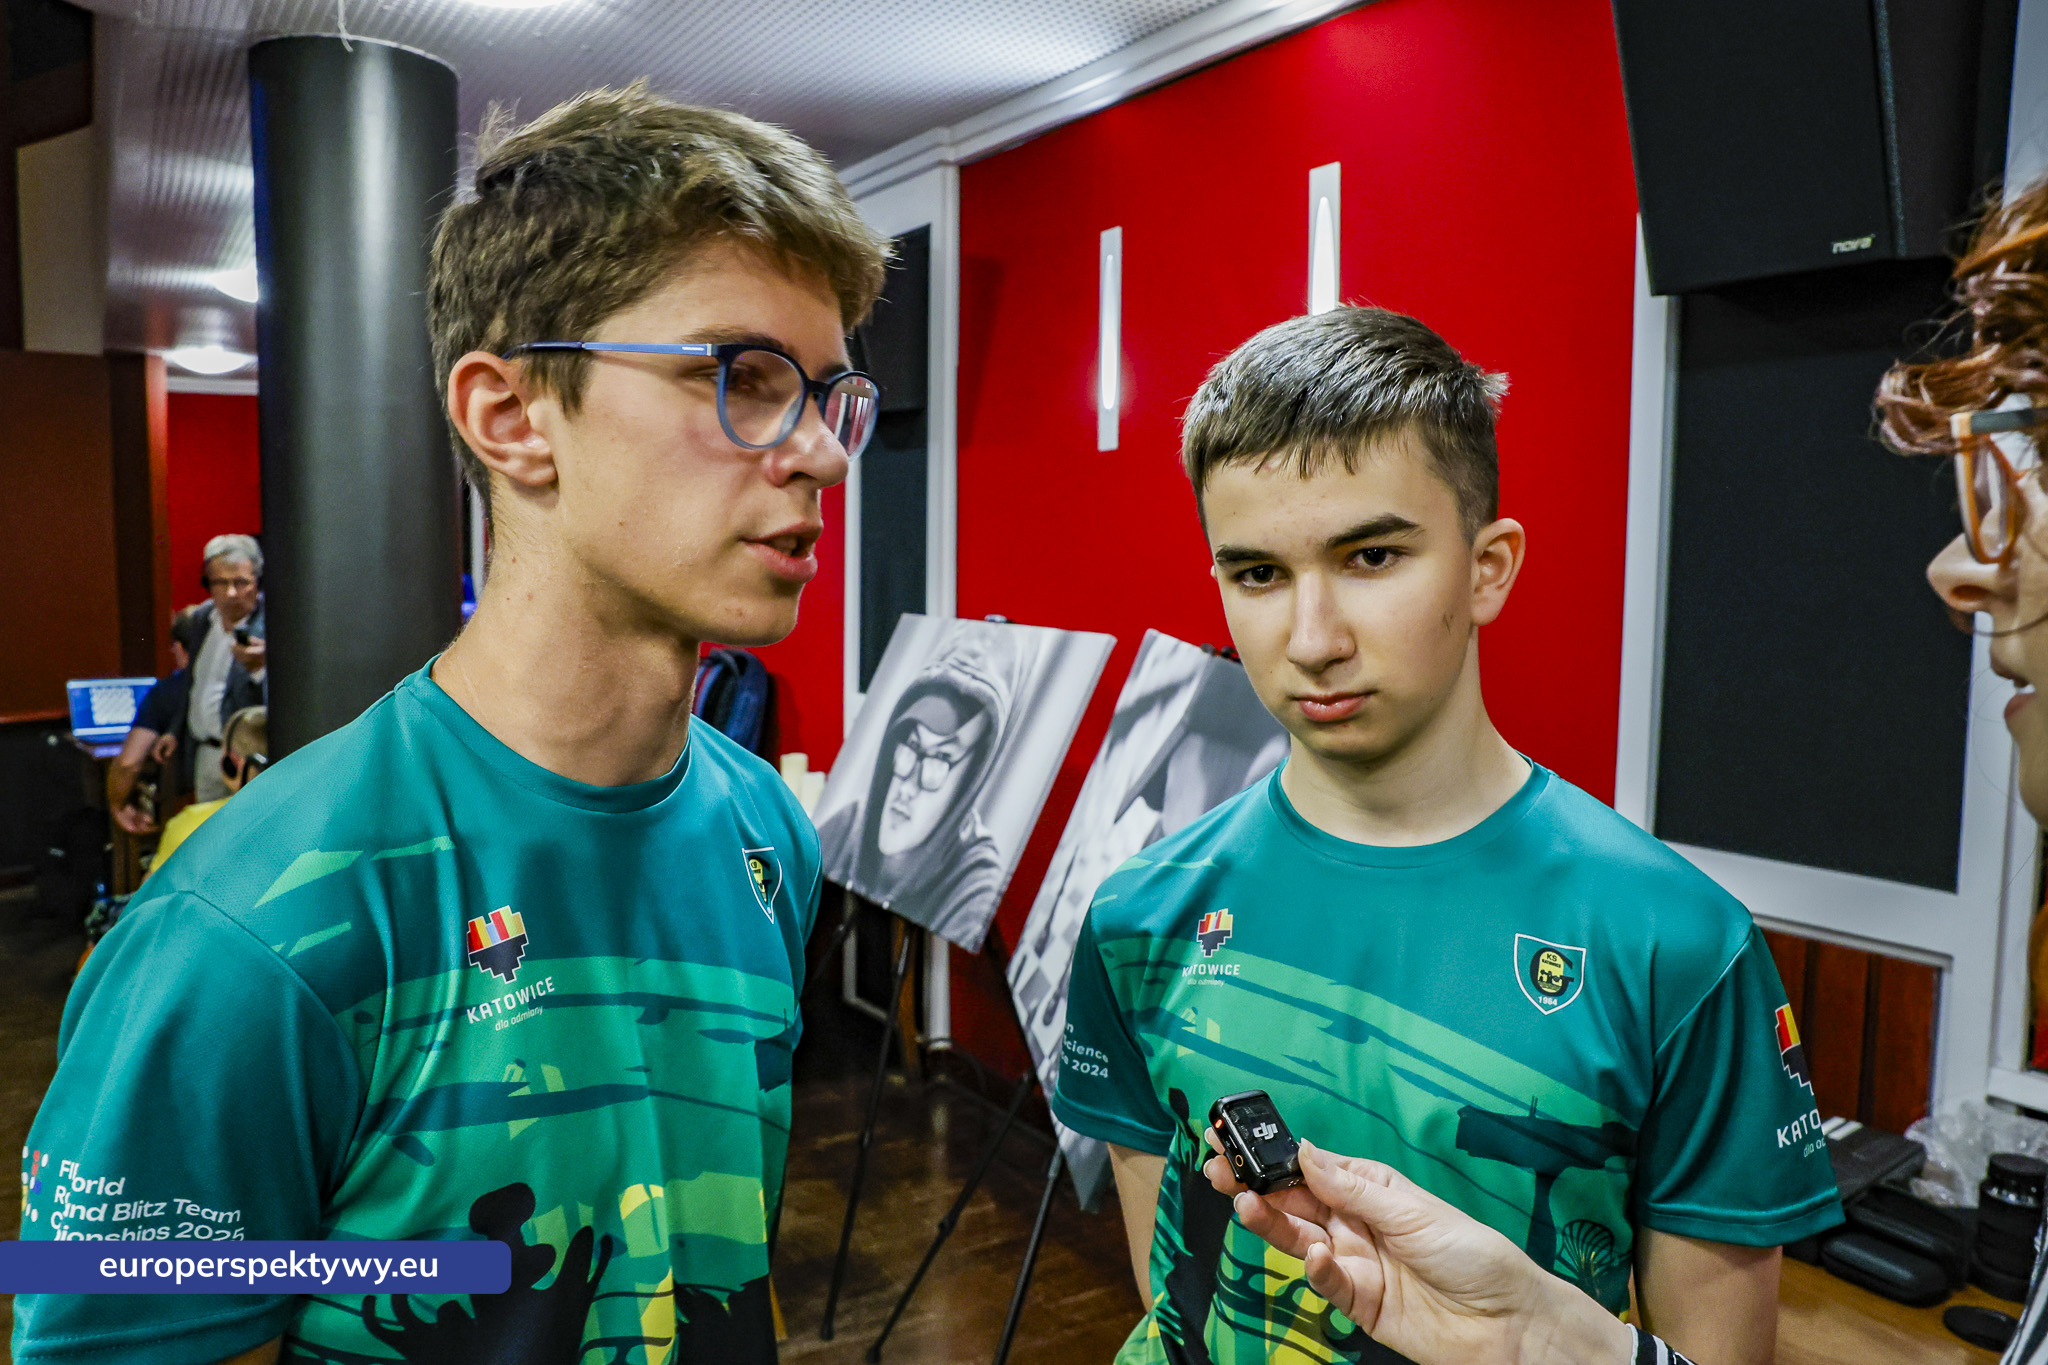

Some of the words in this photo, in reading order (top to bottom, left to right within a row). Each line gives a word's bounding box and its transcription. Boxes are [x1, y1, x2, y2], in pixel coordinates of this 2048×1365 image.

[1546, 953, 1557, 962] KS
[466, 976, 555, 1024] KATOWICE
[1538, 996, 1558, 1006] 1964
[494, 1018, 509, 1031] dla
[510, 1006, 543, 1025] odmiany
[1071, 1059, 1109, 1078] 2024
[1803, 1142, 1815, 1158] dla
[71, 1177, 125, 1196] orld
[112, 1200, 168, 1222] Blitz
[173, 1198, 242, 1224] Team
[54, 1225, 170, 1241] ionships
[175, 1222, 245, 1241] 2025
